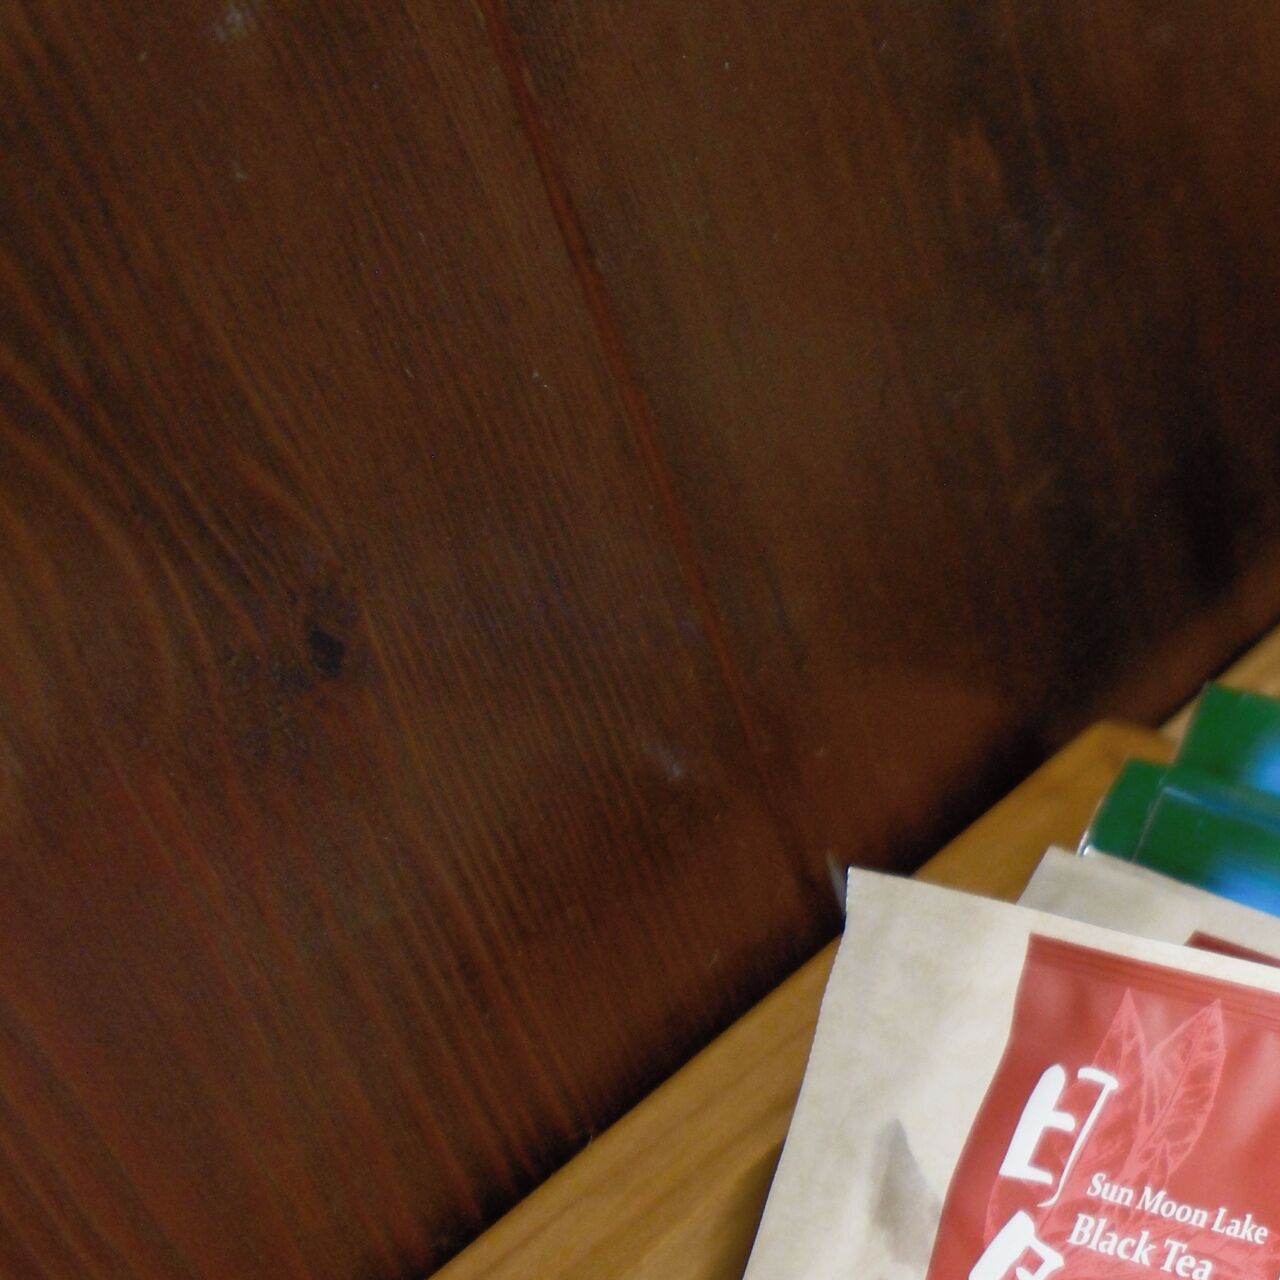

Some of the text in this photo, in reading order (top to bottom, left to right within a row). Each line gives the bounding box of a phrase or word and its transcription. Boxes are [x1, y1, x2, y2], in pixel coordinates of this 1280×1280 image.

[1067, 1212, 1156, 1266] Black
[1086, 1172, 1269, 1245] Sun Moon Lake
